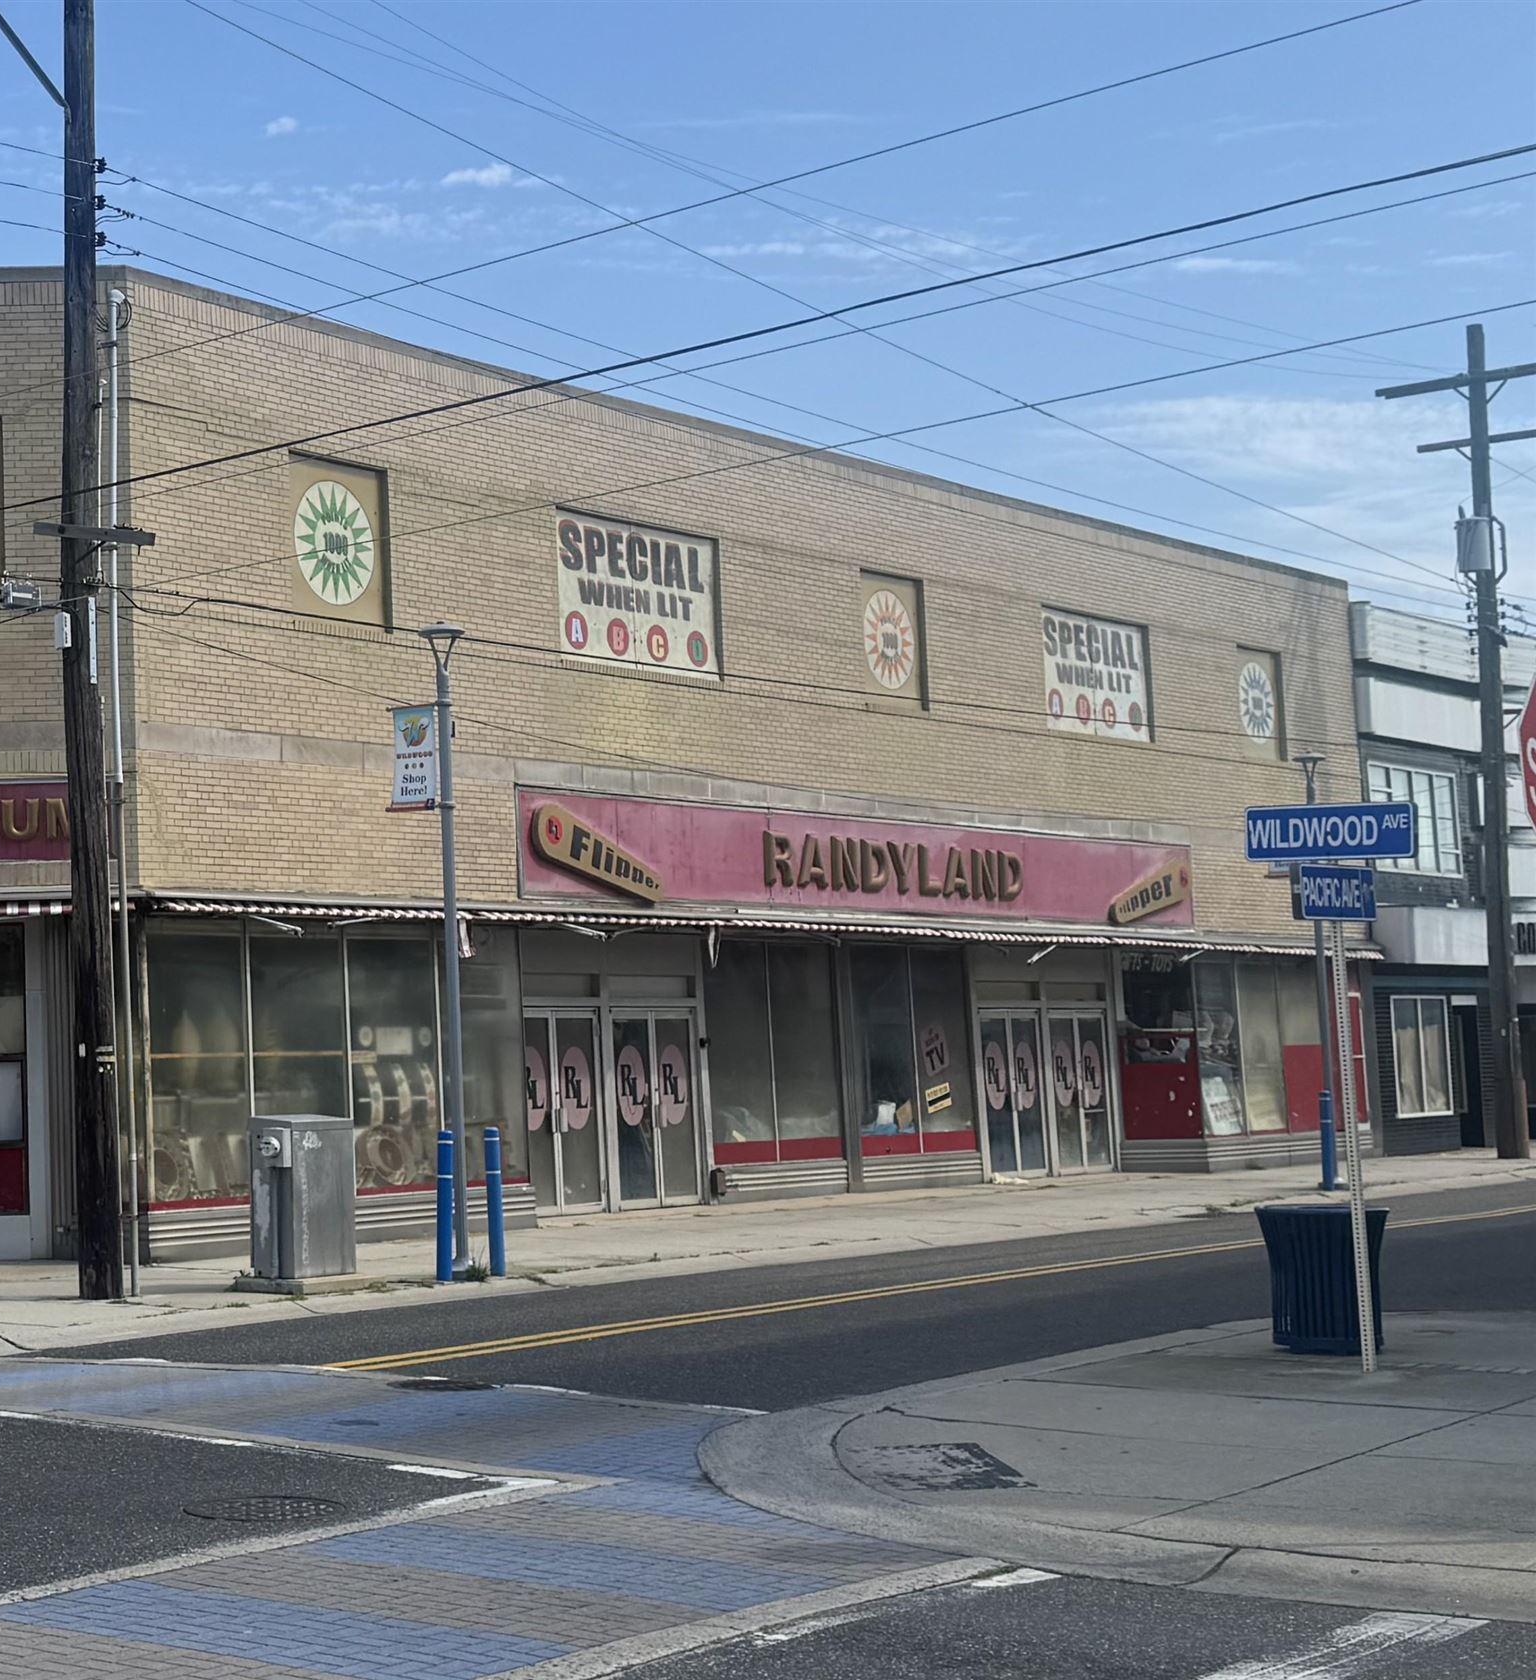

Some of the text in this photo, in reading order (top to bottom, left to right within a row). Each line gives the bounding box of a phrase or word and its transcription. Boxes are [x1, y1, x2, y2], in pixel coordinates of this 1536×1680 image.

[322, 531, 349, 557] 1000
[558, 519, 705, 594] SPECIAL
[577, 577, 693, 622] WHEN LIT
[571, 618, 584, 642] A
[613, 626, 625, 651] B
[651, 634, 664, 658] C
[1043, 615, 1139, 671] SPECIAL
[1055, 662, 1132, 694] WHEN LIT
[396, 750, 434, 760] WILDWOOD
[400, 785, 428, 797] Here!
[401, 773, 427, 785] Shop
[1248, 813, 1409, 850] WILDWOOD AVE
[569, 824, 660, 890] Flipper
[762, 829, 1024, 902] RANDYLAND
[1302, 876, 1361, 909] PACIFIC AVE
[925, 1042, 945, 1071] TV
